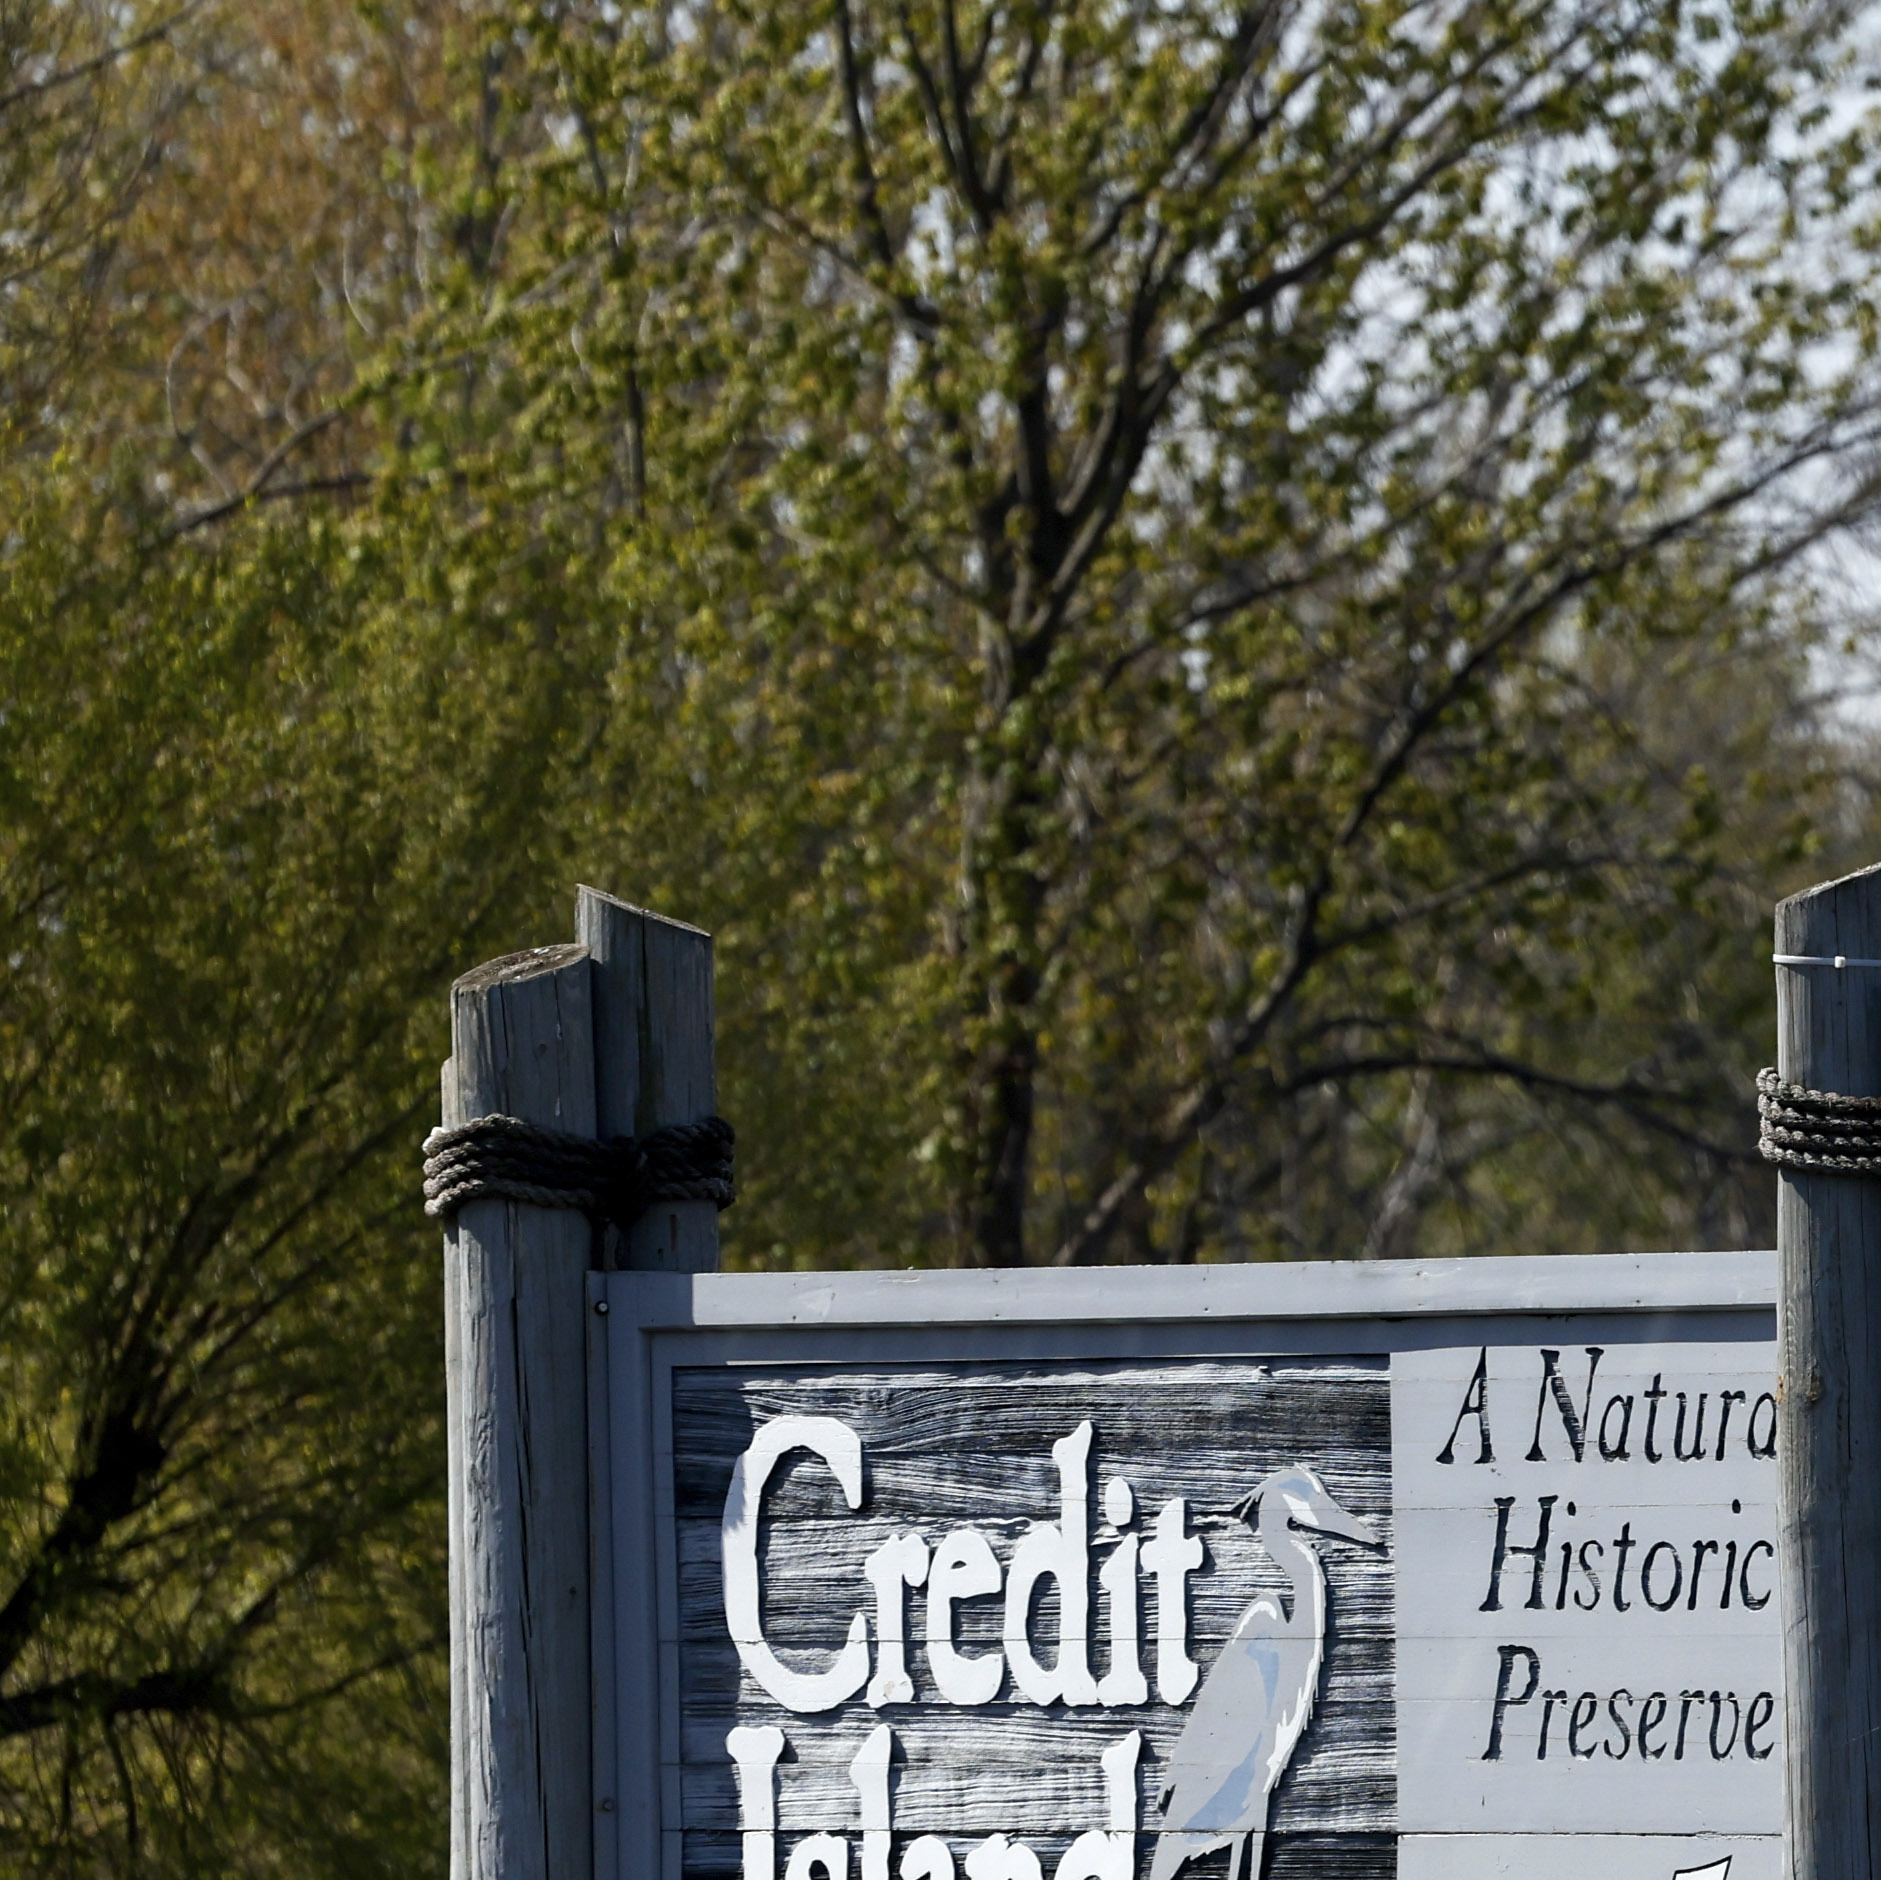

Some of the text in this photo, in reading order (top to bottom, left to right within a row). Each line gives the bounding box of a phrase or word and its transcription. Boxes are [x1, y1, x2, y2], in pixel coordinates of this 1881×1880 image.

[1436, 1346, 1777, 1464] A Natura
[722, 1416, 1203, 1713] Credit
[1478, 1494, 1775, 1612] Historic
[1481, 1643, 1776, 1761] Preserve
